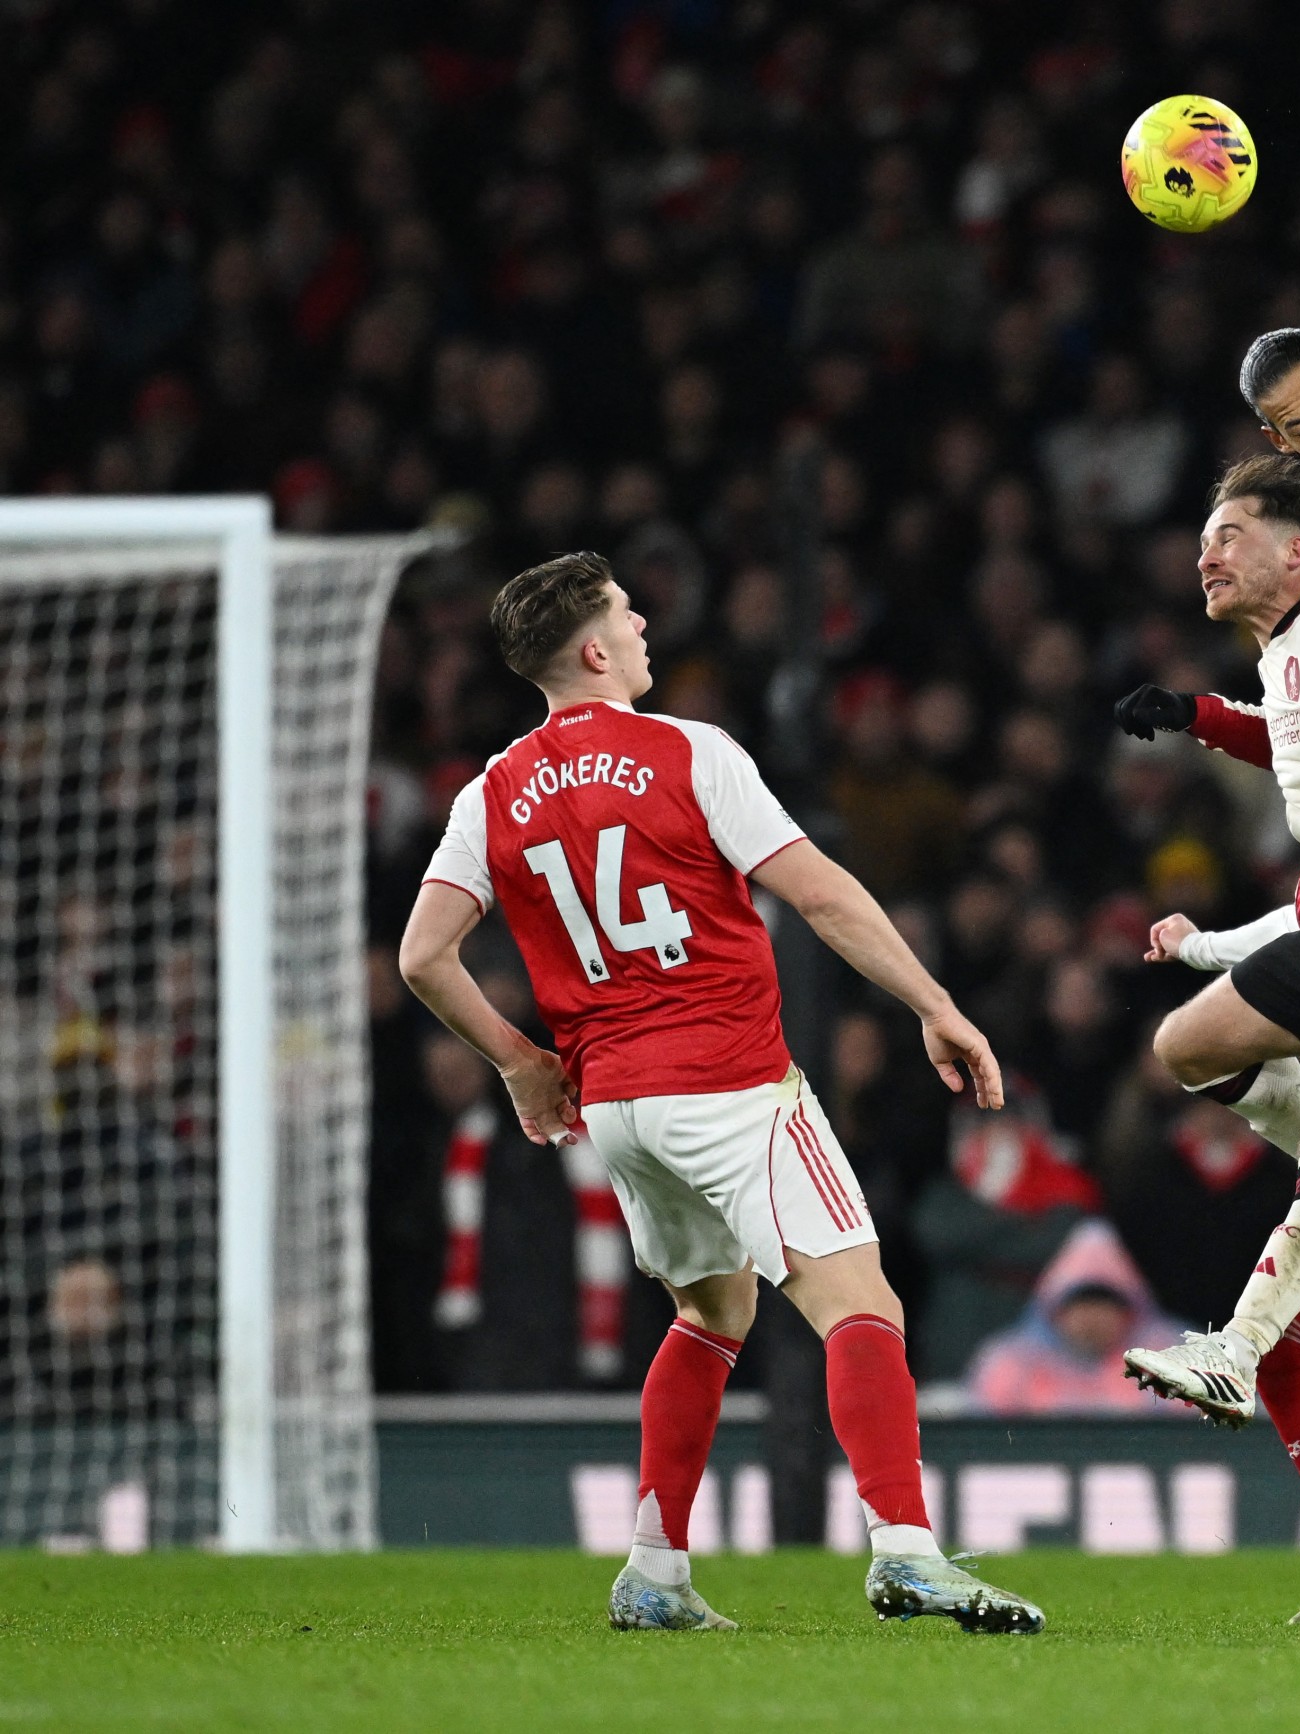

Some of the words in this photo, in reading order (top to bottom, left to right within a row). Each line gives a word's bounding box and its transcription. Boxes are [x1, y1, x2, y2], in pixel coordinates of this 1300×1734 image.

[558, 709, 593, 728] Arsenal
[509, 753, 655, 825] GYÖKERES
[522, 824, 693, 984] 14
